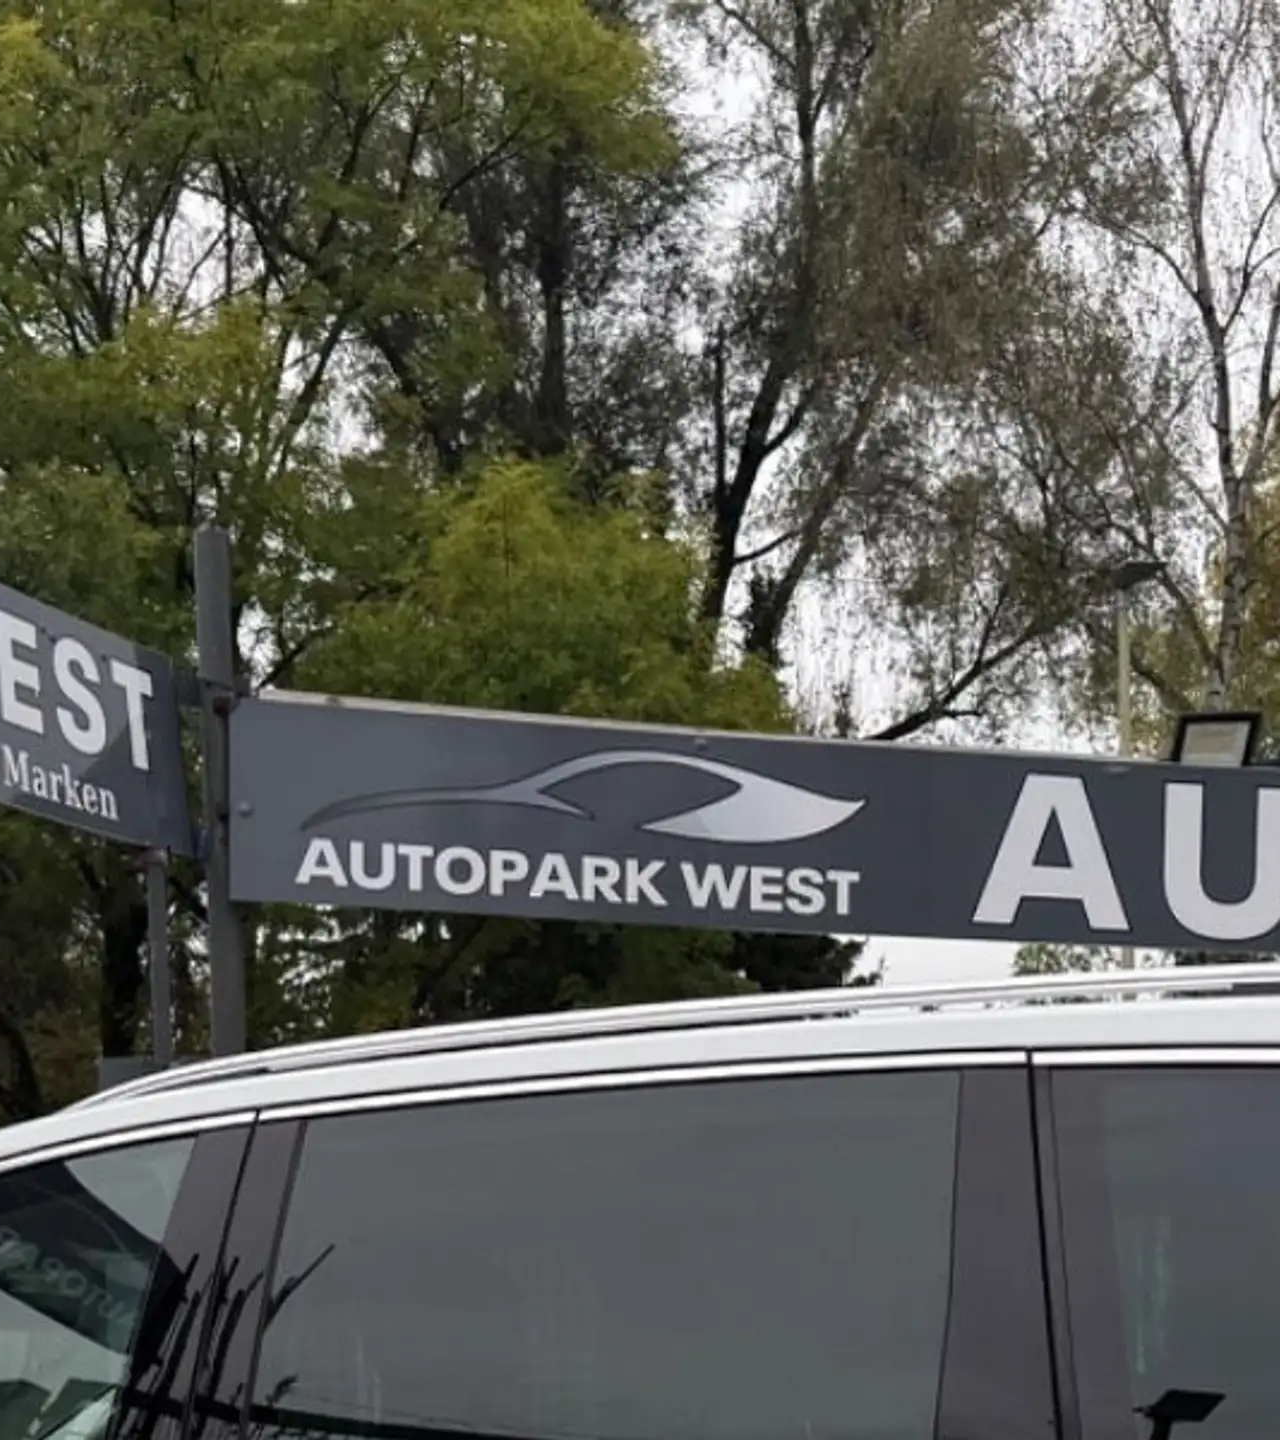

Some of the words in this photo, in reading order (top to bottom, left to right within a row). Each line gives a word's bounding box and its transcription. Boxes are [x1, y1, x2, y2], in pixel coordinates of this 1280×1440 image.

[2, 744, 120, 820] Marken
[295, 837, 667, 906] AUTOPARK
[680, 862, 860, 915] WEST
